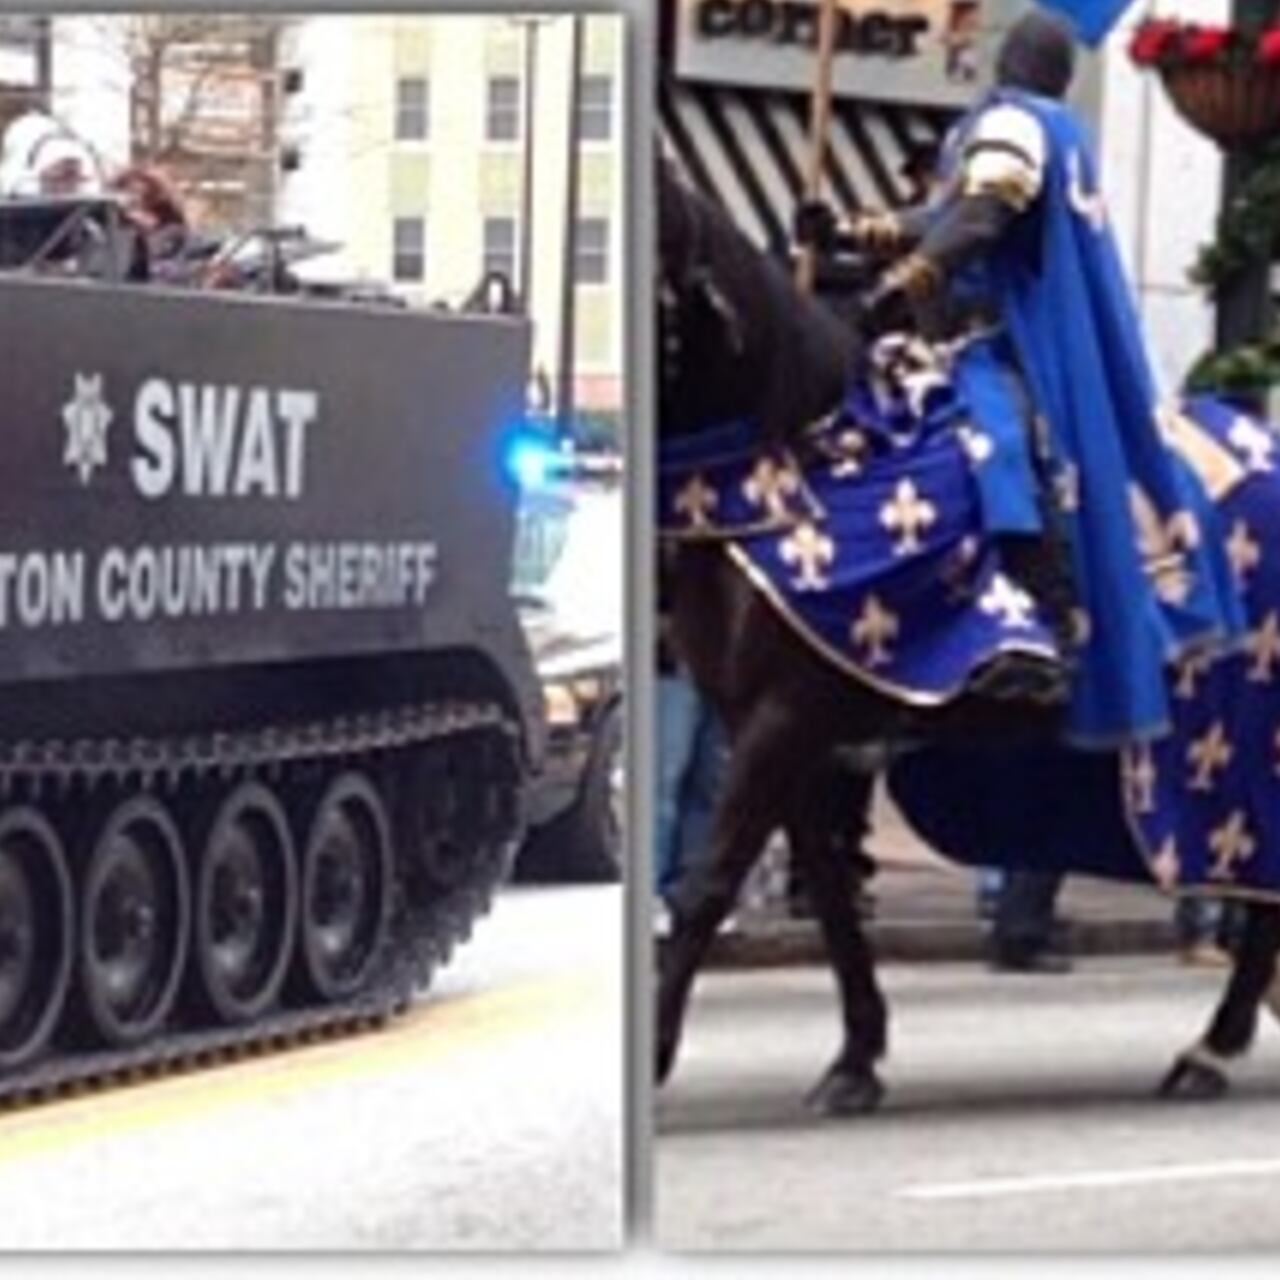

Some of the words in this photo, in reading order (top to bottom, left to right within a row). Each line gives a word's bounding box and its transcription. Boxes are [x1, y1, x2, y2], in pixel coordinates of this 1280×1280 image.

[130, 377, 320, 500] SWAT
[97, 545, 276, 622] COUNTY
[282, 540, 438, 610] SHERIFF
